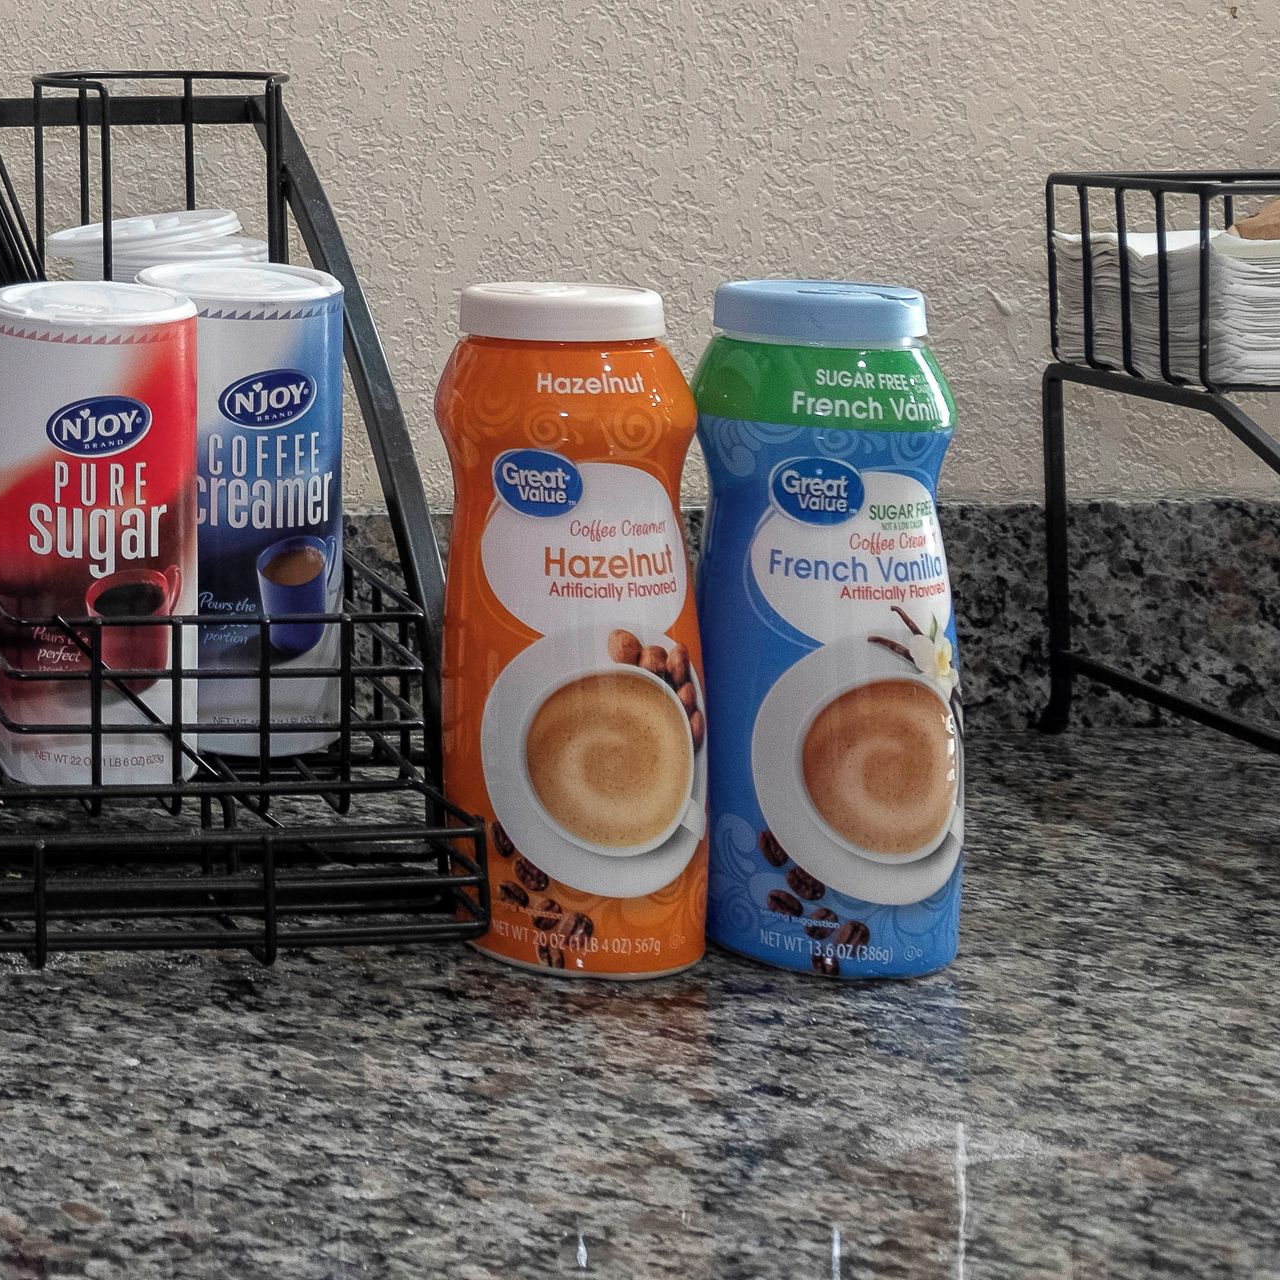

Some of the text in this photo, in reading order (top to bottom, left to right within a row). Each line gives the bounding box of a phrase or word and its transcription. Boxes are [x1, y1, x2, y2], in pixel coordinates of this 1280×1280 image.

[537, 372, 645, 394] Hazelnut
[816, 368, 875, 389] SUGAR
[877, 373, 909, 391] FREE
[257, 410, 293, 422] BRAND
[792, 390, 883, 420] French
[84, 439, 124, 450] BRAND
[208, 431, 320, 477] COFFEE
[54, 461, 147, 507] PURE
[502, 462, 567, 489] Great
[781, 469, 849, 498] Great
[197, 471, 333, 530] creamer
[518, 485, 567, 504] Value
[798, 494, 849, 513] Value
[869, 501, 932, 520] SUGAR FREE
[28, 502, 167, 579] sugar
[570, 519, 617, 542] Coffee
[849, 532, 937, 555] Coffee Crear
[545, 544, 673, 579] Hazelnut
[769, 548, 943, 583] French Vanilla
[199, 591, 257, 612] Pours the
[549, 578, 677, 602] Artificially Flavored
[840, 585, 907, 603] Artificially
[204, 630, 248, 644] portion
[37, 645, 81, 664] perfect
[35, 750, 51, 762] NET
[53, 752, 68, 765] WT
[70, 755, 81, 767] 22
[109, 757, 122, 768] LB
[123, 756, 130, 768] 6
[791, 916, 840, 929] suggestion
[492, 919, 661, 956] NET WT 20 OZ (1 LB 4 OZ) 567g
[760, 928, 894, 964] NET WT 13.6 OZ (386g)
